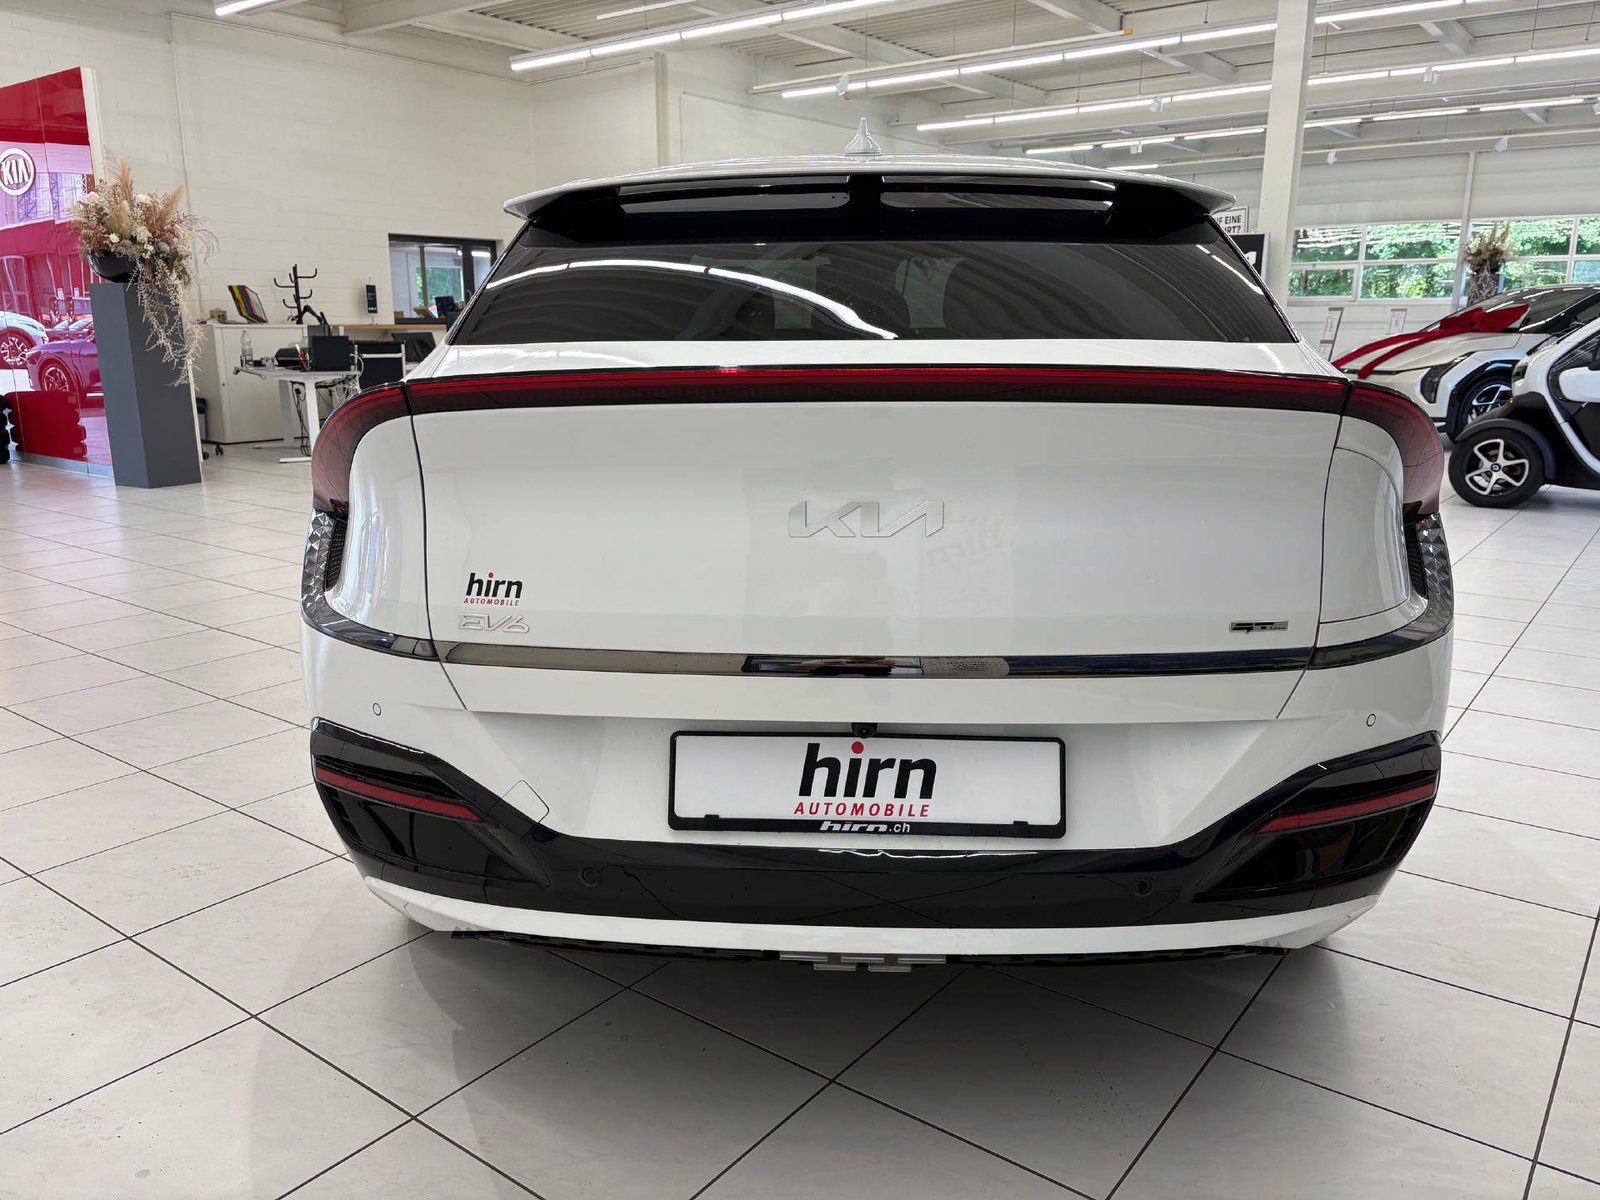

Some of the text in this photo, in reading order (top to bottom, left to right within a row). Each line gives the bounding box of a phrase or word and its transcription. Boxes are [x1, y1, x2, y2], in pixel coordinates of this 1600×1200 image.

[2, 157, 30, 186] KIA
[1224, 215, 1242, 225] EINE
[788, 499, 944, 539] KIA
[465, 571, 524, 599] hirn
[463, 598, 520, 607] AUTOMOBILE
[458, 612, 530, 633] EV6
[799, 741, 937, 800] hirn
[794, 801, 930, 818] AUTOMOBILE
[819, 820, 911, 834] hirn.ch
